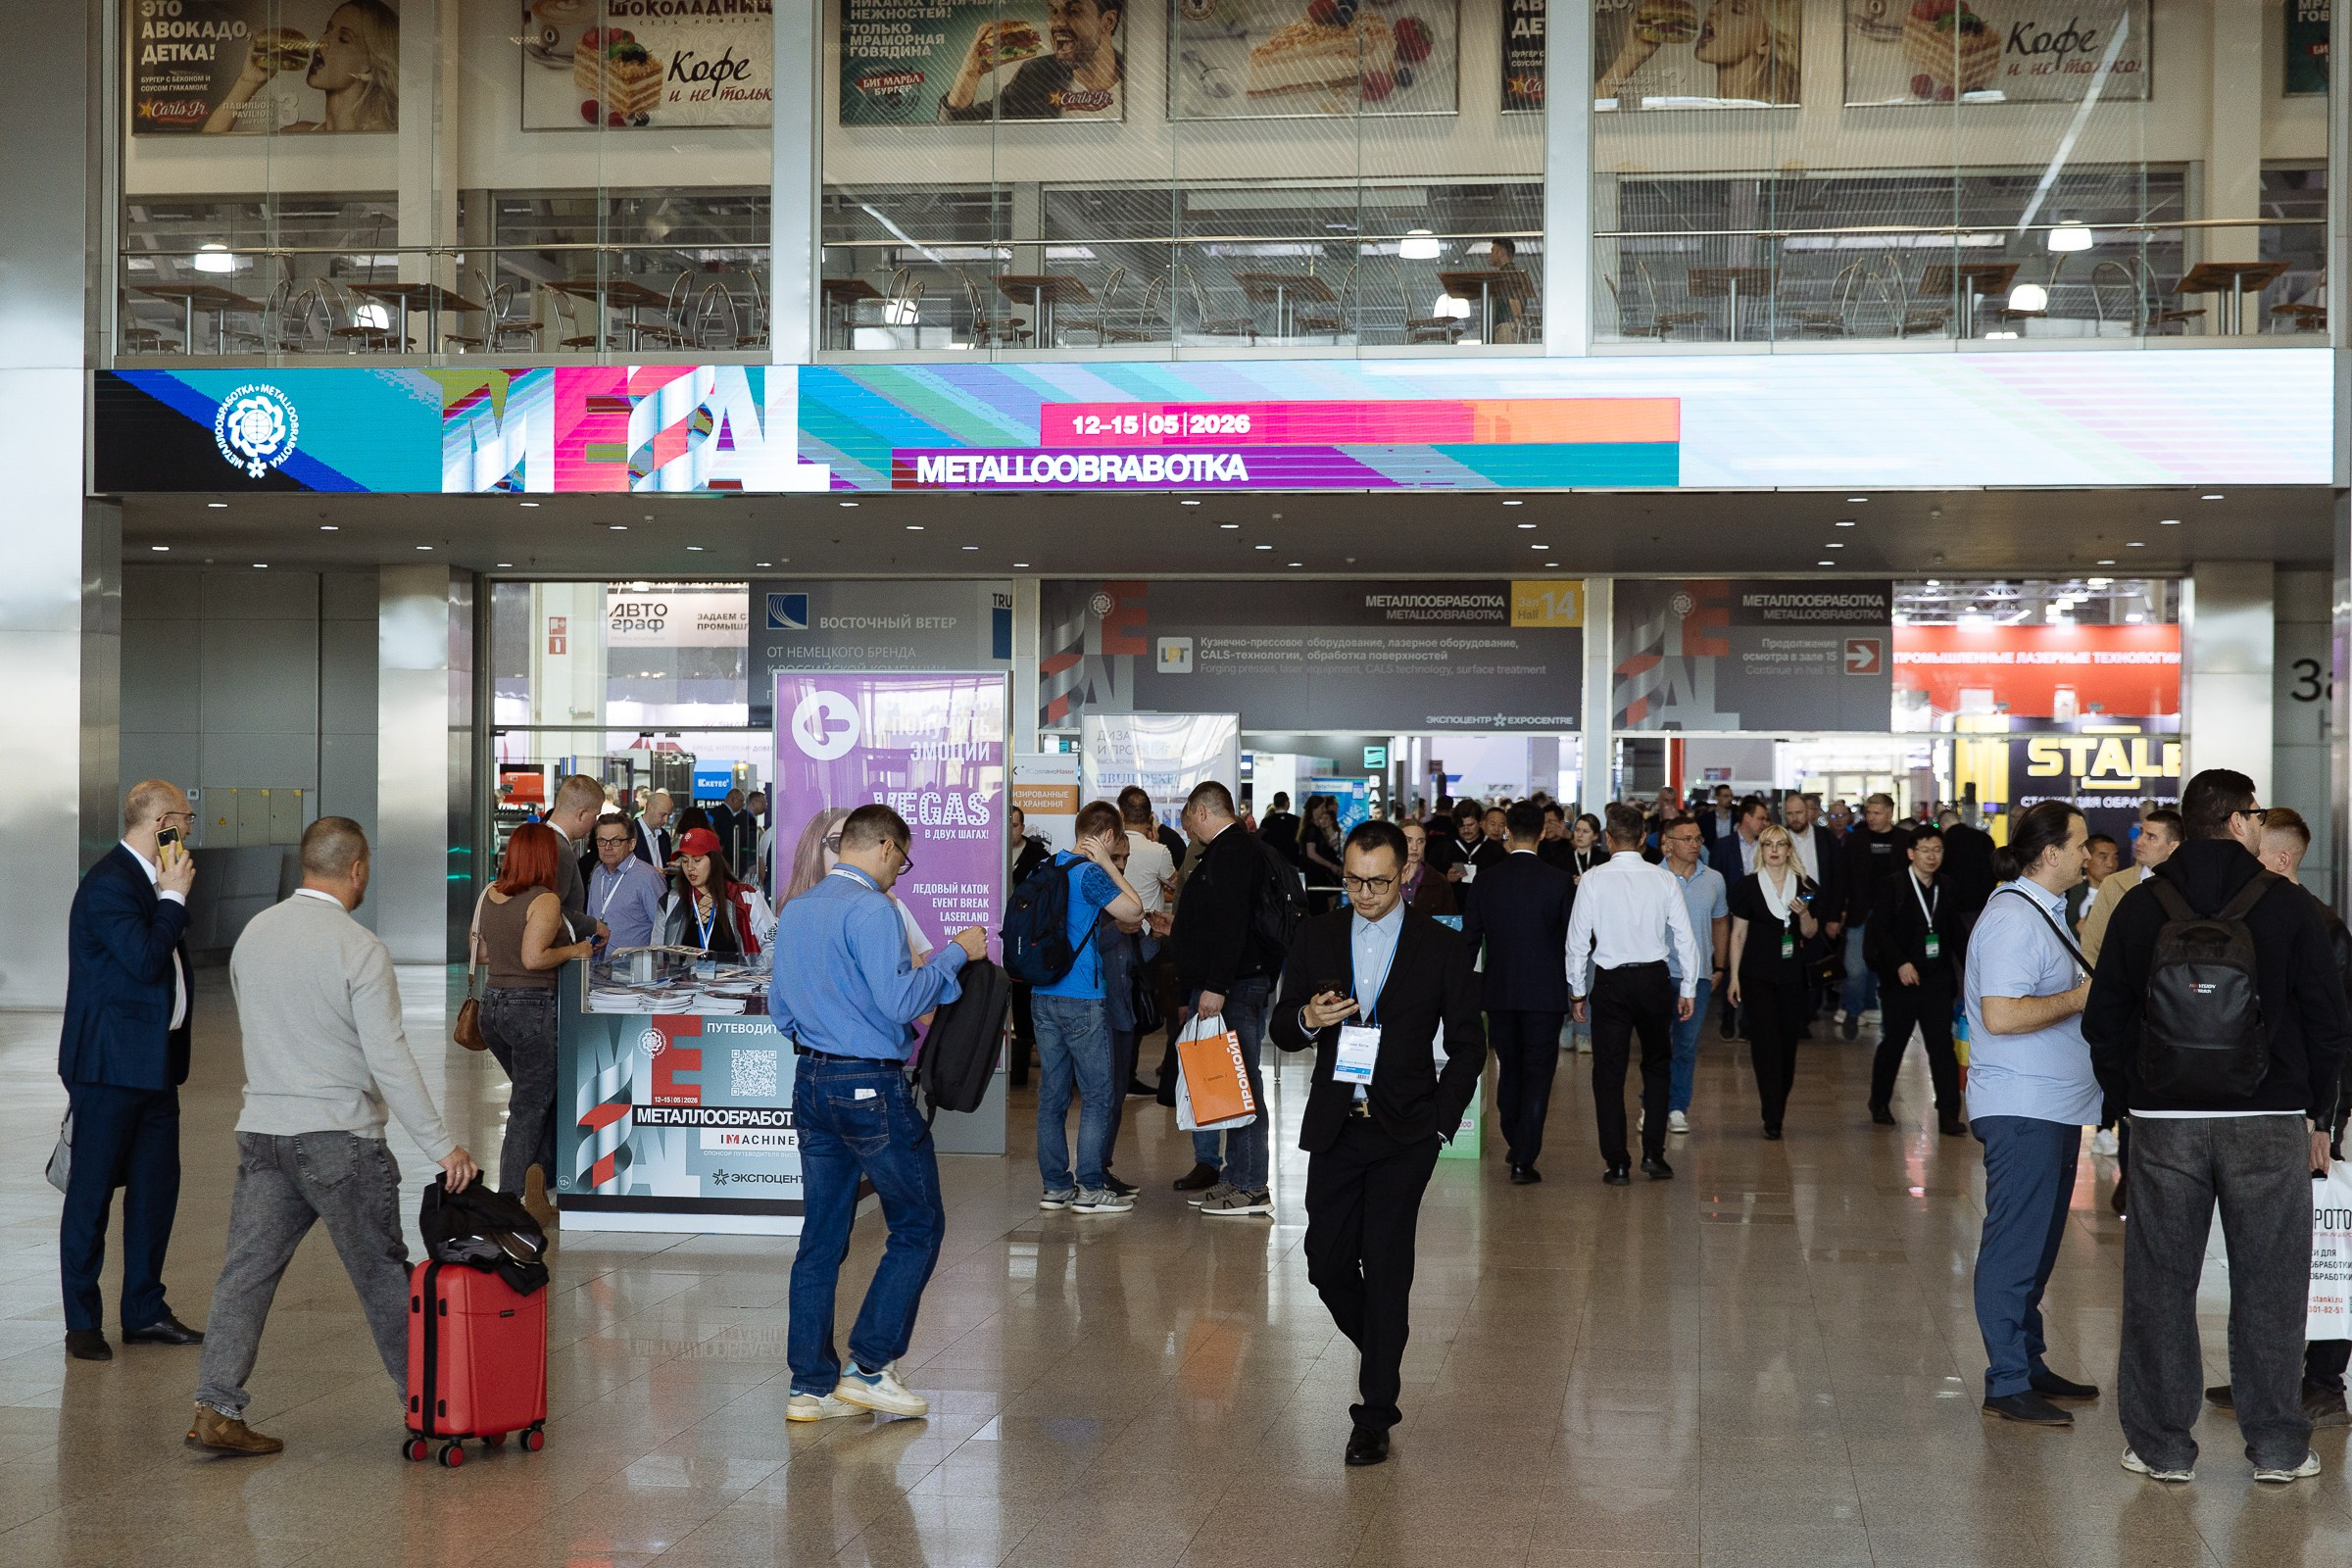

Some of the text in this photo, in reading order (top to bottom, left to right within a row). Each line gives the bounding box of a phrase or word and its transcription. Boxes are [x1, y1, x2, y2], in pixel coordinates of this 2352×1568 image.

[141, 0, 183, 17] ЭТО
[851, 8, 952, 20] НЕЖНОСТЕЙ!
[141, 21, 253, 42] АВОКАДО,
[851, 24, 911, 35] ТОЛЬКО
[850, 34, 945, 46] МРАМОРНАЯ
[2006, 17, 2099, 71] Кофе
[141, 44, 216, 65] ДЕТКА!
[850, 46, 932, 59] ГОВЯДИНА
[667, 46, 752, 97] Кофе
[863, 74, 920, 88] БИГ МАРБЛ
[668, 89, 682, 102] и
[689, 88, 711, 102] не
[917, 454, 1250, 483] METALLOOBRABOTKA
[1366, 595, 1504, 608] МЕТАЛЛООБРАБОТКА
[1541, 591, 1576, 620] 14
[1742, 595, 1884, 607] МЕТАЛЛООБРАБОТКА
[609, 604, 668, 617] АВТО
[697, 612, 736, 621] ЗАДАЕМ
[1386, 610, 1504, 620] METALLOOBRABOTKA
[1764, 610, 1884, 619] METALLOOBRABOTKA
[612, 618, 664, 633] граф
[819, 614, 957, 629] ВОСТОЧНЫЙ ВЕТЕР
[1200, 637, 1519, 650] Кузнечно-прессовое оборудование, лазерное оборудование,
[766, 647, 916, 660] ОТ НЕМЕЦКОГО БРЕНДА
[1200, 651, 1447, 662] CALS-технологии, обработка поверхностей
[1426, 715, 1573, 725] ЭКСПОЦЕНТР EXPOCENTRE
[910, 741, 990, 764] ЭМОЦИИ
[873, 791, 991, 825] VEGAS
[925, 829, 989, 841] В ДВУХ ШАГАХ!
[912, 882, 989, 895] ЛЕДОВЫЙ КАТОК
[932, 898, 989, 908] EVENT BREAK
[940, 911, 989, 922] LASERLAND
[1226, 1031, 1255, 1111] ПРОМОЙЛ
[2321, 1249, 2336, 1257] ДЛЯ
